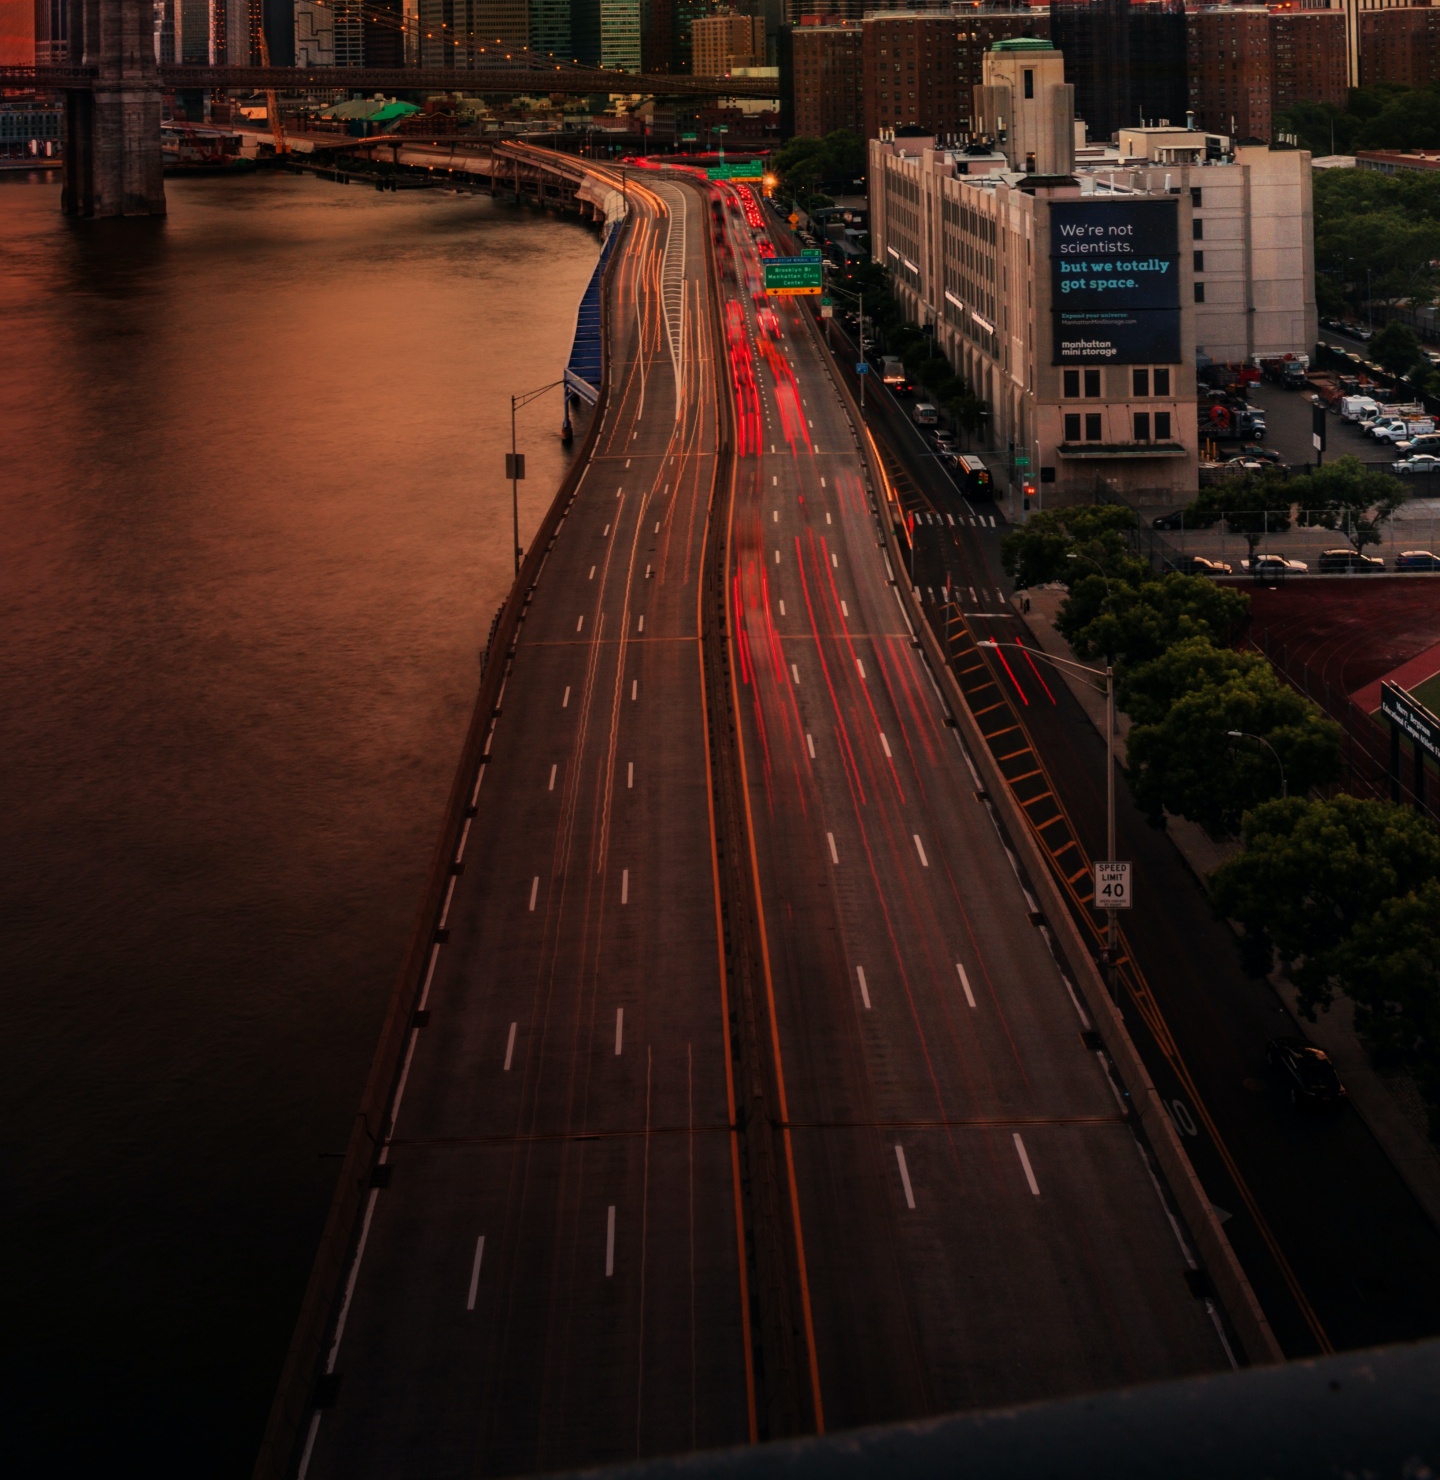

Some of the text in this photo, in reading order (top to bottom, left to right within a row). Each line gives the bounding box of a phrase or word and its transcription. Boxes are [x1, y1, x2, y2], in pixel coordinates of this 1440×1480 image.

[1060, 224, 1133, 236] We're not
[1060, 241, 1134, 253] scientists,
[1060, 259, 1170, 274] but we totally
[1061, 278, 1139, 293] got space.
[1061, 338, 1112, 349] manhattan
[1062, 347, 1117, 357] mini storage
[1099, 864, 1127, 872] SPEED
[1102, 873, 1123, 881] LIMIT
[1102, 883, 1124, 897] 40
